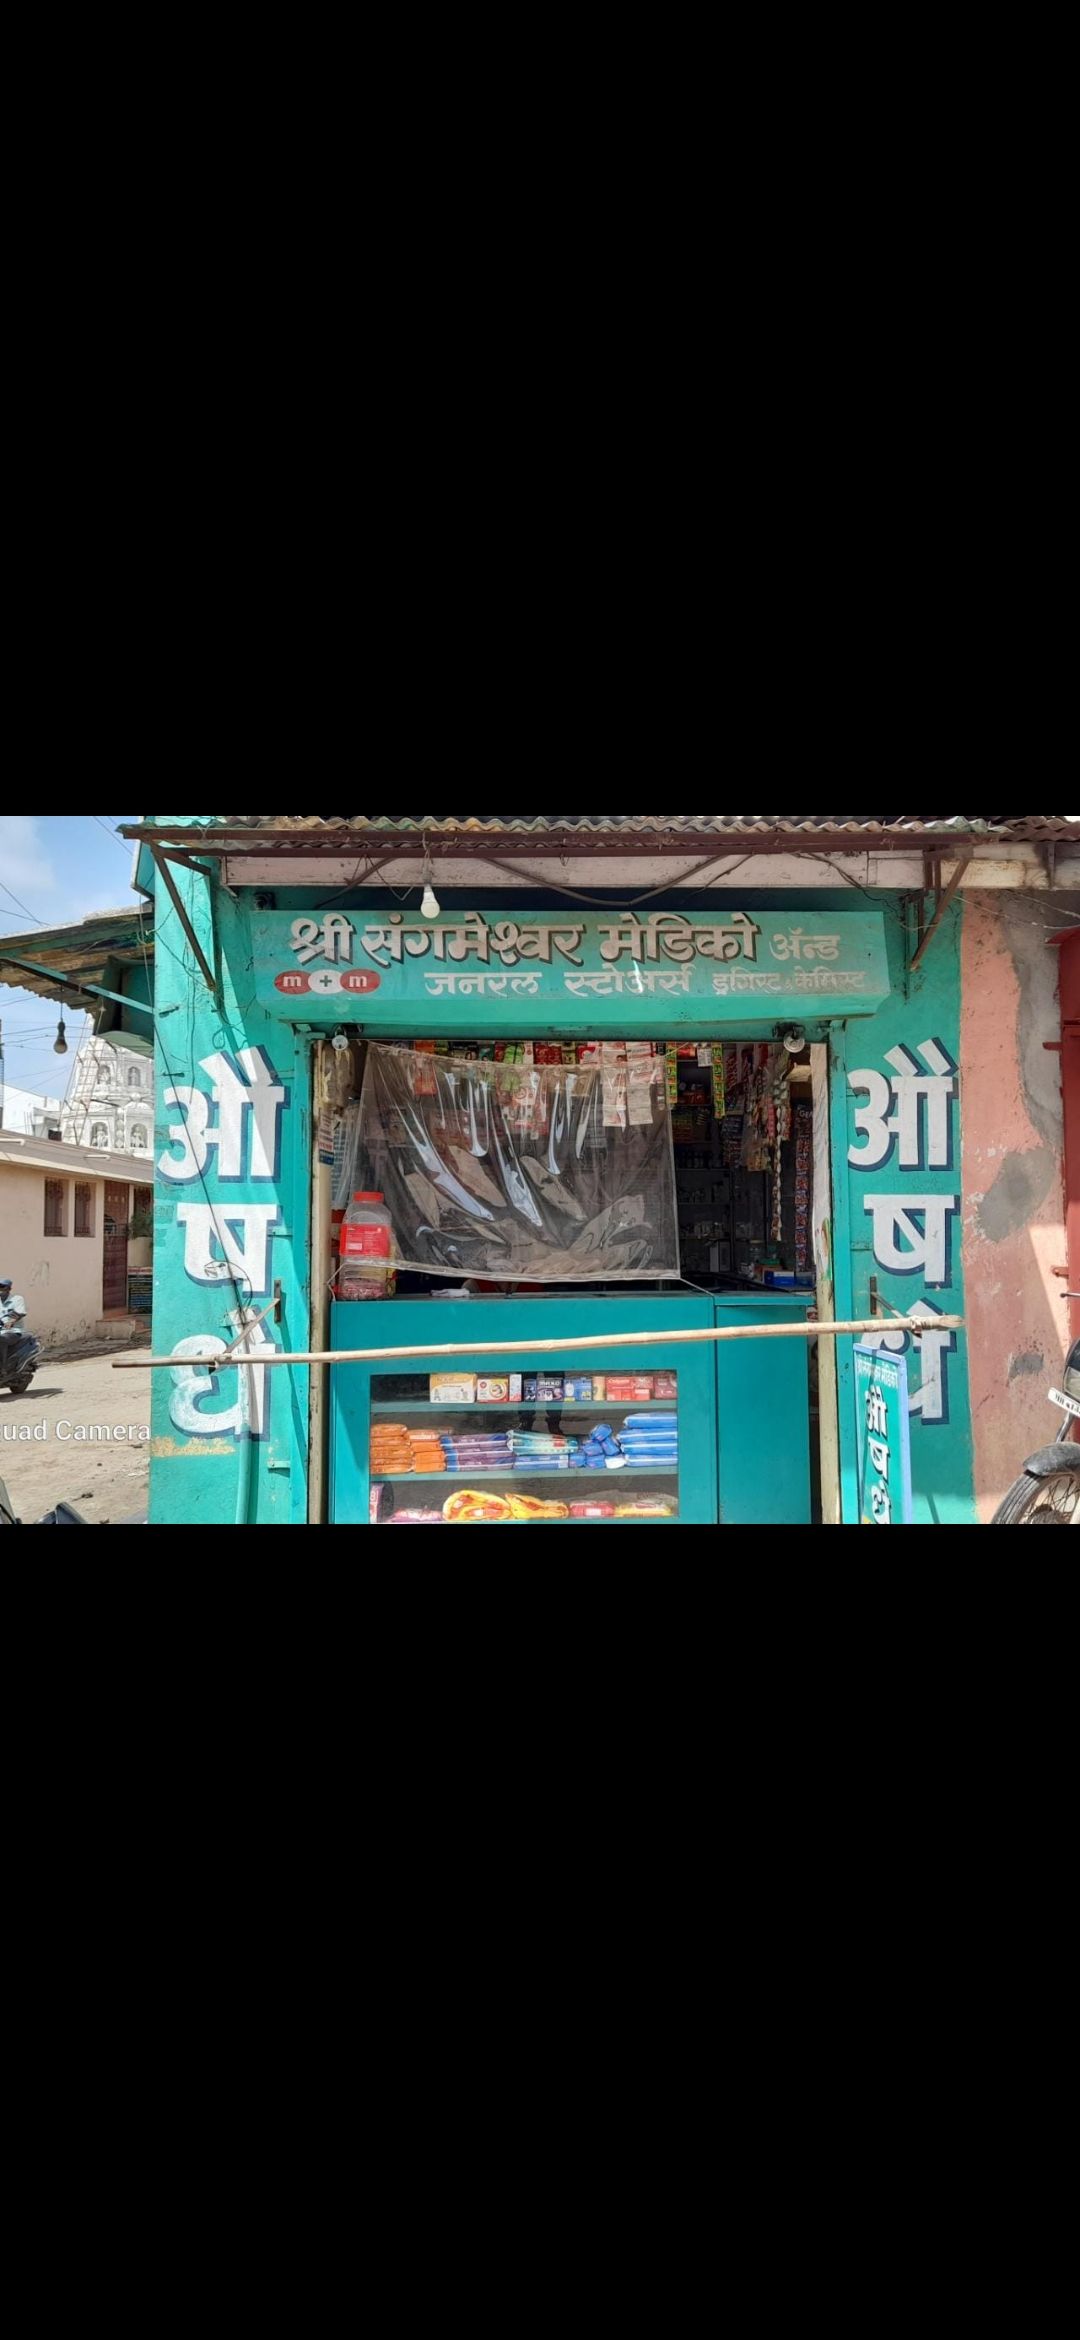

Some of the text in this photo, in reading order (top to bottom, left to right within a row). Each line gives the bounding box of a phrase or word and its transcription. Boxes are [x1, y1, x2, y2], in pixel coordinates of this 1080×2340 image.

[289, 913, 357, 965] श्री
[360, 912, 587, 968] संगमेश्वर
[598, 911, 762, 963] मेडिको
[423, 972, 542, 997] जनरल
[563, 962, 697, 997] स्टोअर्स
